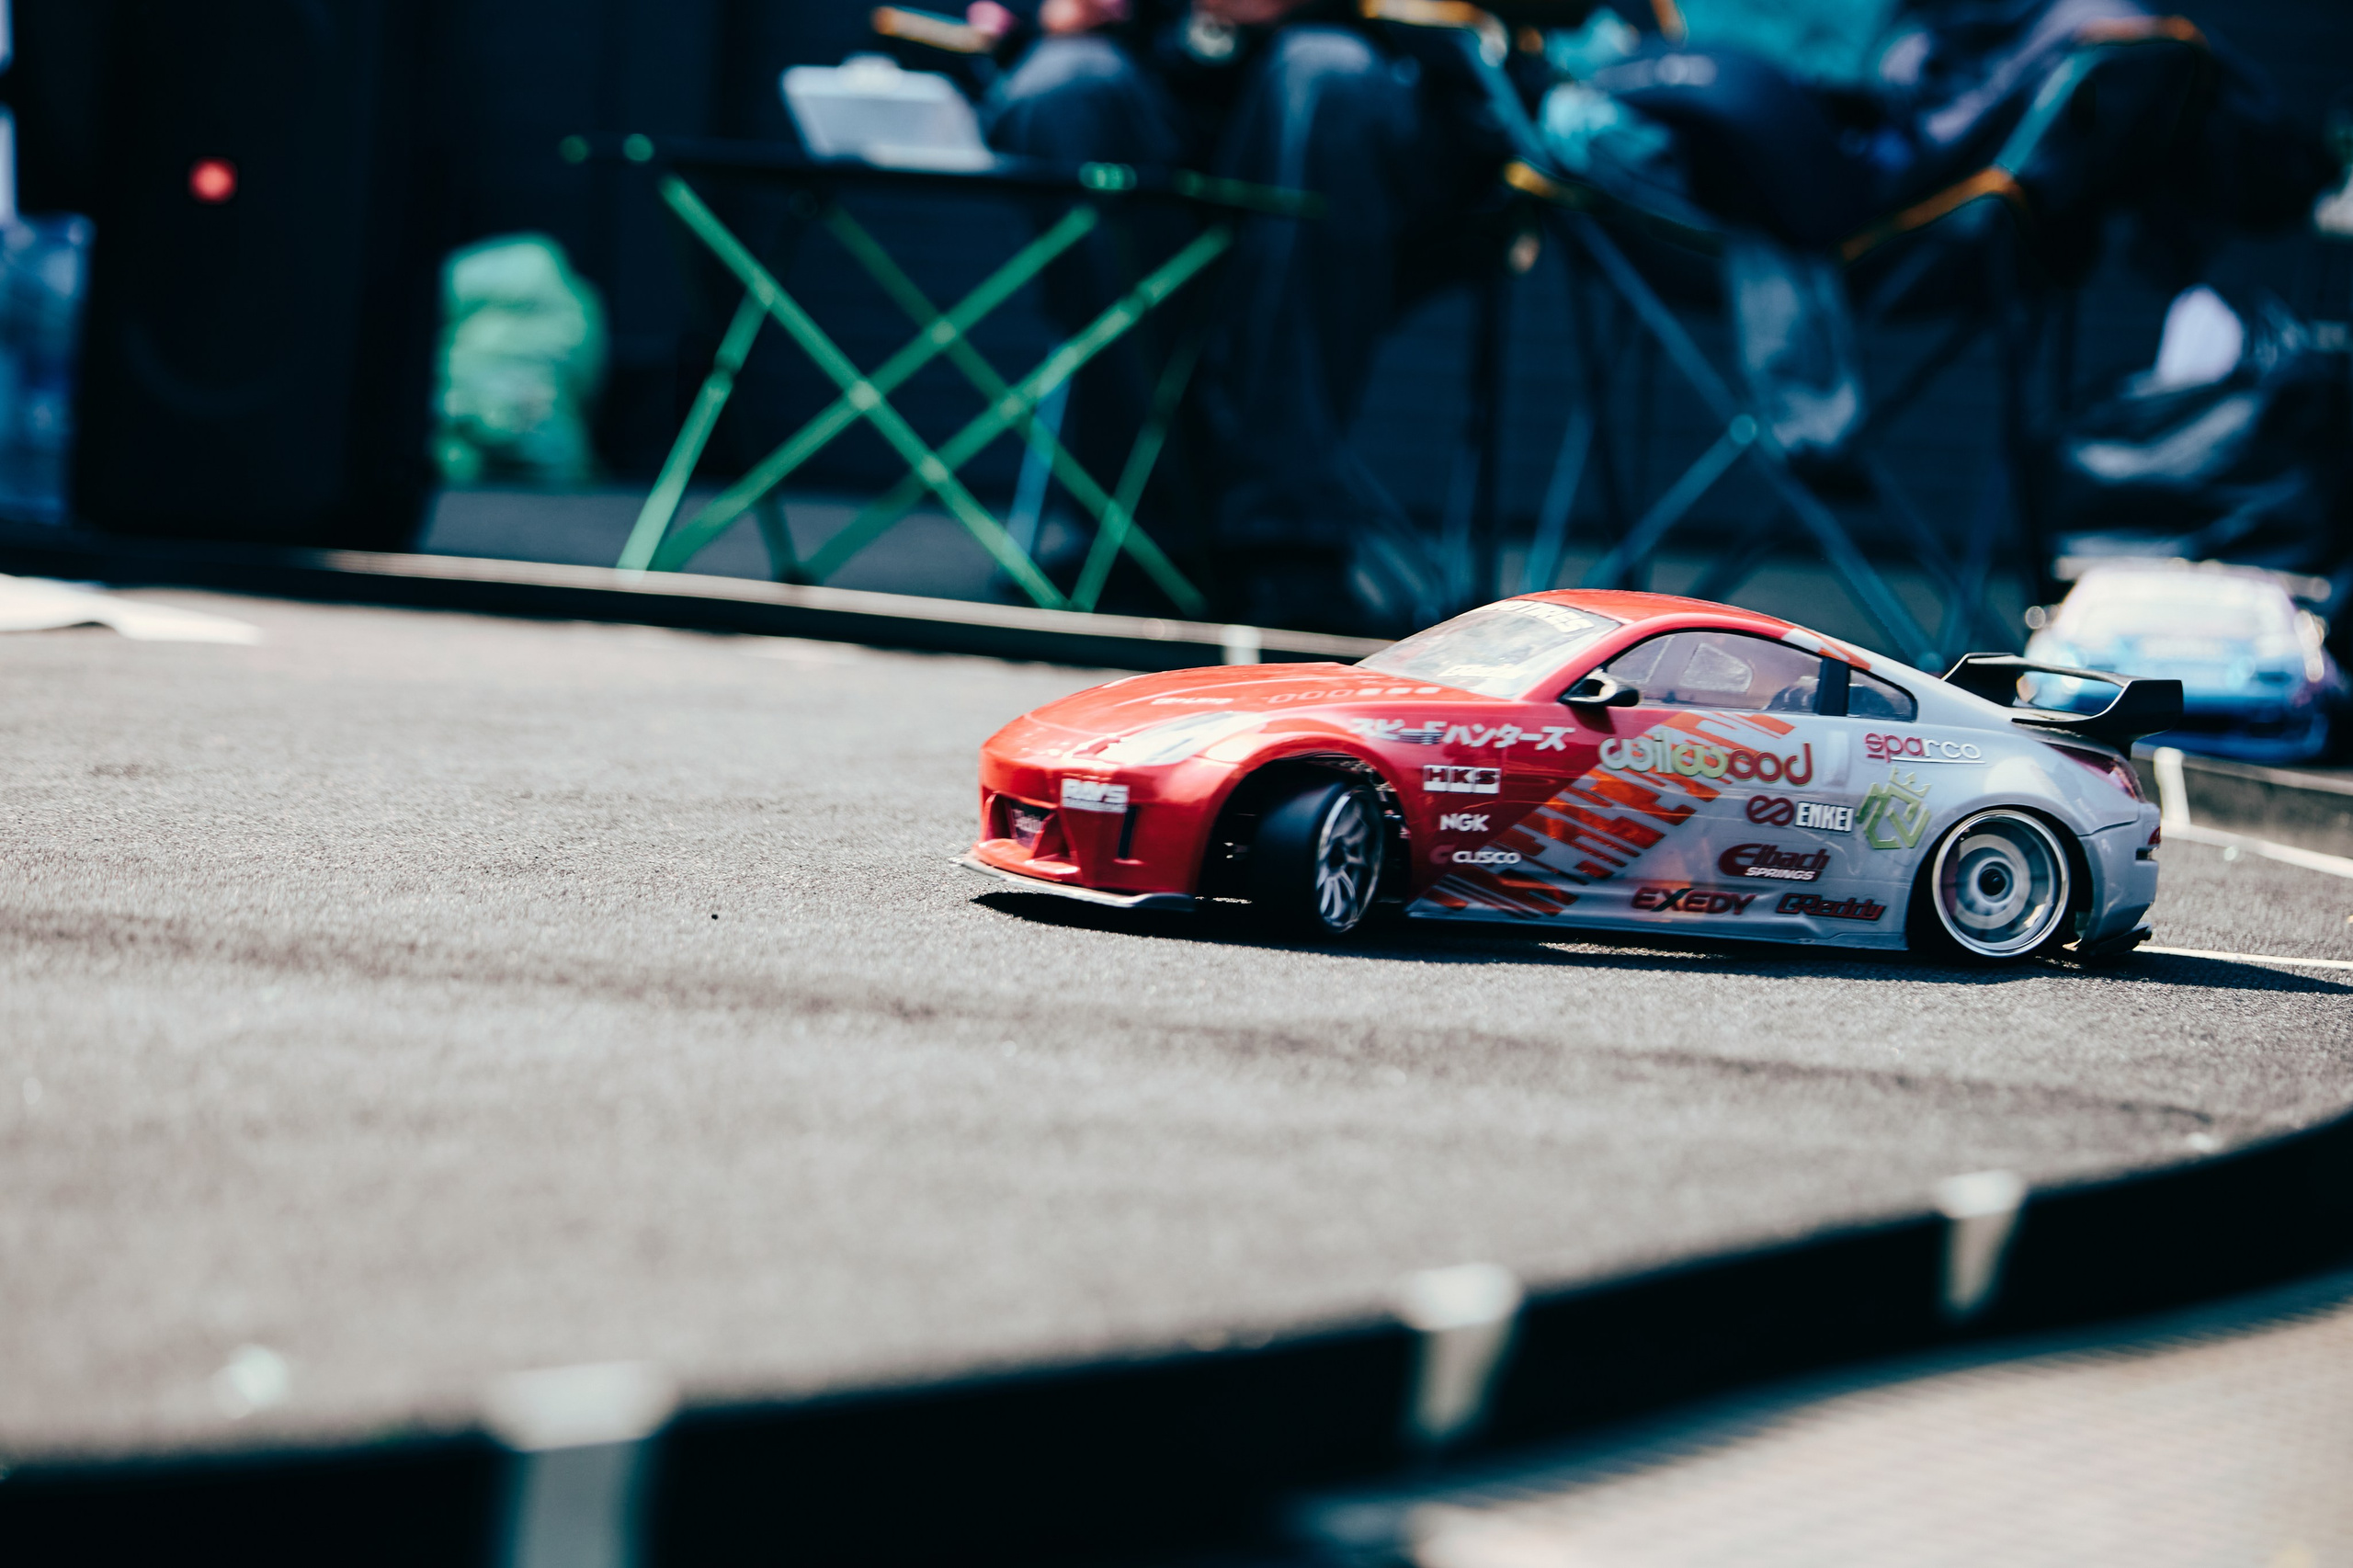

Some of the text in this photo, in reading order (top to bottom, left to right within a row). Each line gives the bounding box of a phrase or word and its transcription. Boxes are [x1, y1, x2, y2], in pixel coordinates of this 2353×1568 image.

[1598, 729, 1813, 787] wilwood
[1864, 733, 1983, 763] sparco
[1427, 767, 1498, 787] HKS
[1439, 812, 1491, 832] NGK
[1795, 801, 1855, 833] ENKEI
[1745, 866, 1816, 881] SPRINGS
[1631, 887, 1757, 915] EXEDY
